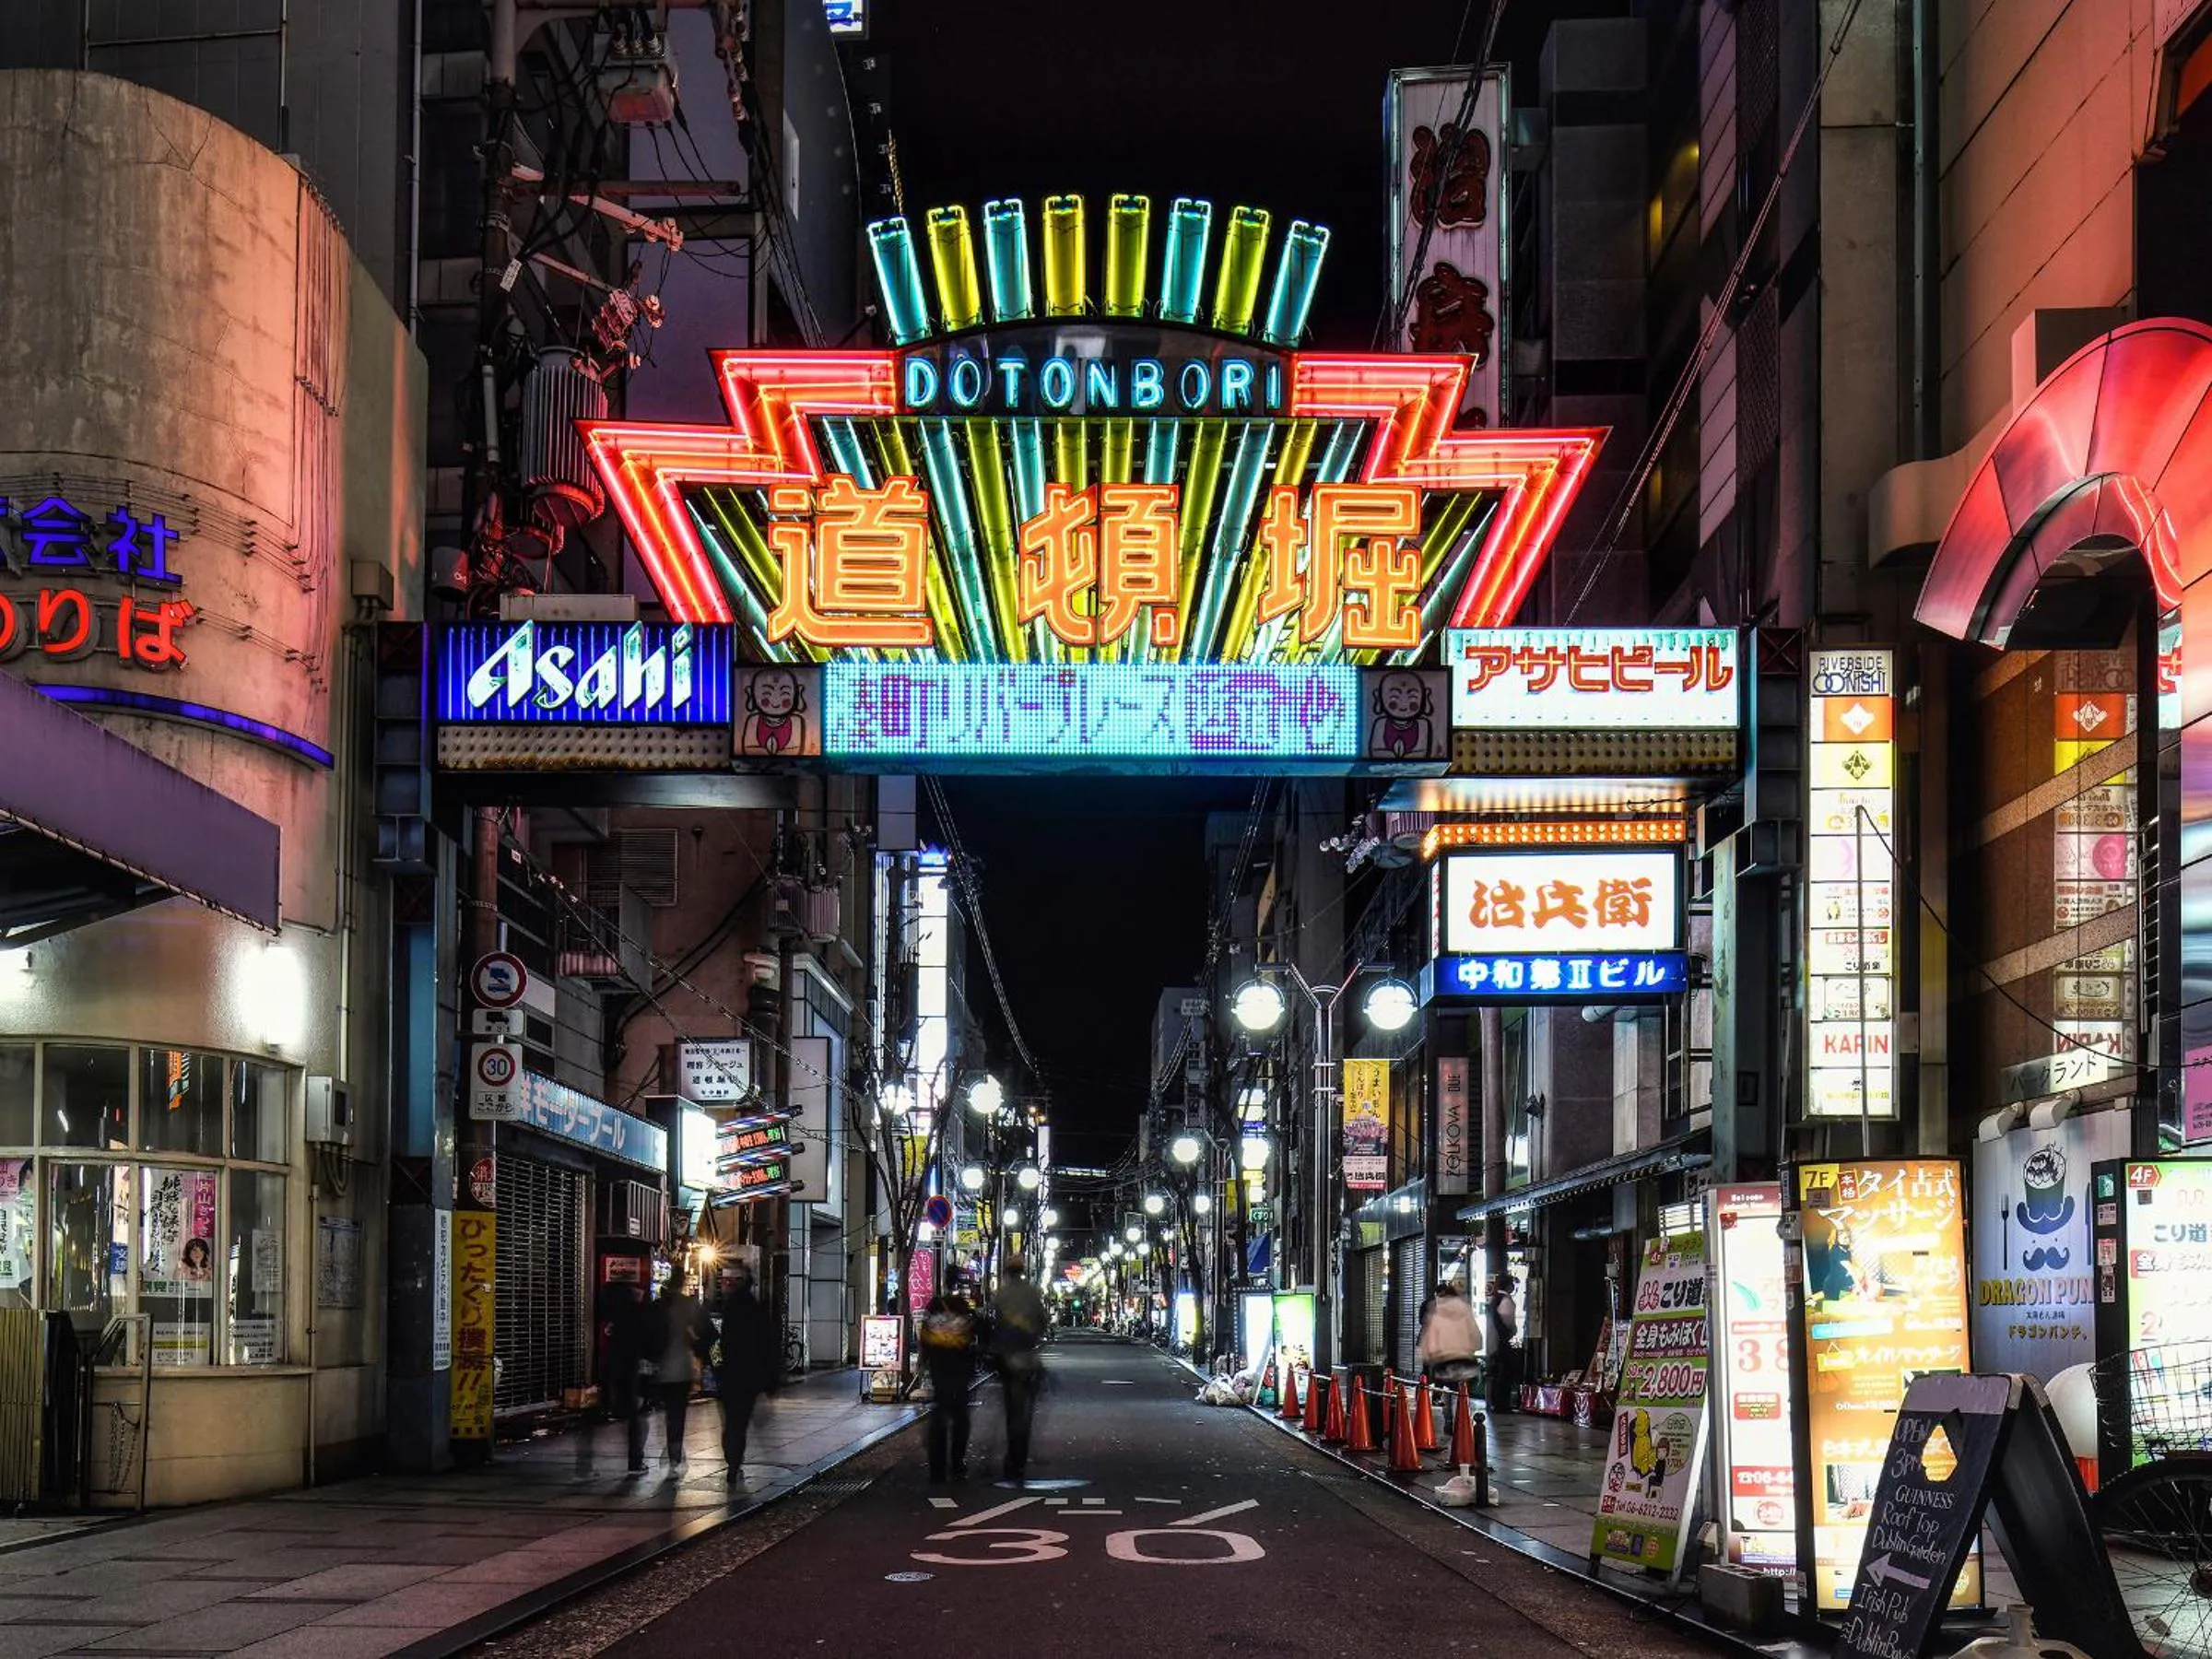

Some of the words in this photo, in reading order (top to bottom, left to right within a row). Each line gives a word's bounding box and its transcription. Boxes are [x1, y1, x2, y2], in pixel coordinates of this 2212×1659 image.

[904, 357, 1281, 409] DOTONBORI
[768, 474, 1423, 648] 道頓堀
[466, 619, 693, 711] Asahi
[1465, 645, 1735, 693] アサヒビール
[1818, 655, 1886, 671] RIVERSIDE
[1469, 876, 1653, 929] 治兵衛
[486, 1058, 508, 1077] 30
[1805, 1171, 1830, 1187] 7F
[1840, 1173, 1856, 1198] 本格
[1858, 1167, 1956, 1202] タイ古式
[2130, 1166, 2153, 1183] 4F
[1818, 1197, 1956, 1230] マッサージ
[1979, 1277, 2052, 1306] DRAGON
[1895, 1418, 1930, 1443] OPEN
[1895, 1484, 1955, 1510] GUINNESS
[1881, 1501, 1915, 1528] Roof
[1915, 1511, 1940, 1535] Top
[910, 1528, 1266, 1565] 30
[1887, 1590, 1910, 1623] Pub
